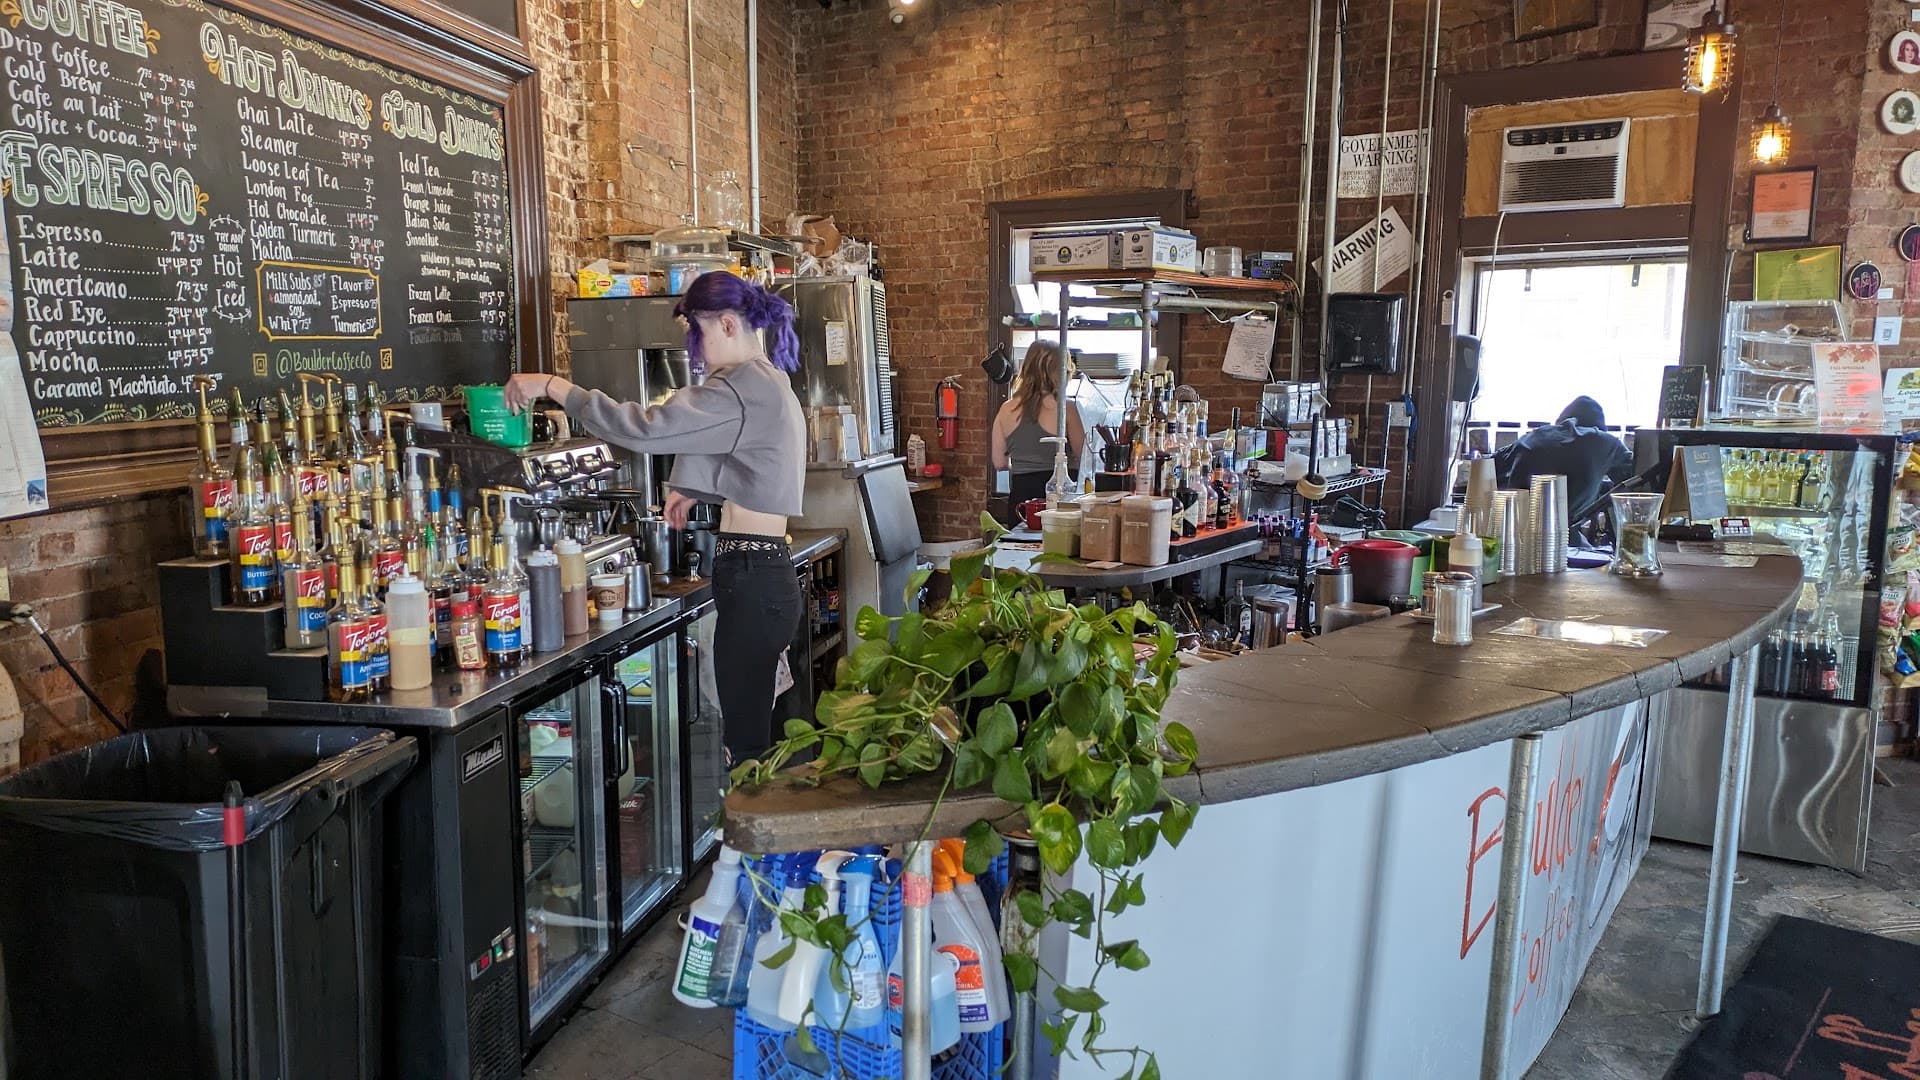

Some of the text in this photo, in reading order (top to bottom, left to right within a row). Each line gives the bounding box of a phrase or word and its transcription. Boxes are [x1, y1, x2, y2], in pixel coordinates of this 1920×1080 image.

[22, 0, 148, 57] COFFEE
[0, 27, 43, 61] Drip
[52, 42, 110, 77] Coffee
[5, 56, 46, 82] Cold
[58, 69, 102, 95] Brew
[200, 22, 369, 130] HOT DRINKS
[9, 82, 52, 106] Cafe
[64, 96, 83, 114] au
[93, 98, 122, 121] lait
[12, 103, 69, 134] Coffee
[87, 120, 137, 147] Cocoa
[237, 97, 270, 126] Chai
[276, 107, 315, 137] Latte
[381, 90, 501, 161] COLD DRINKS
[241, 125, 299, 156] Steamer
[1, 130, 197, 225] ESPRESSO
[241, 151, 280, 177] Loose
[284, 162, 309, 188] Leaf
[315, 166, 339, 190] Tea
[399, 152, 440, 178] Iced Tea
[245, 176, 313, 207] London Fog
[403, 193, 451, 214] Orange Juice
[248, 199, 269, 219] Hot
[276, 202, 327, 226] Chocolate
[405, 211, 450, 232] Italian Soda
[16, 215, 103, 244] Espresso
[250, 218, 284, 239] Golden
[290, 223, 337, 247] Turmeric
[406, 231, 439, 247] Smoothie
[18, 243, 80, 270] Latte
[251, 238, 293, 261] Matcha
[212, 254, 245, 278] Hot
[20, 266, 127, 299] Americano
[266, 271, 288, 290] Milk
[330, 274, 363, 292] Flavor
[408, 284, 451, 302] Frozen Latte
[216, 286, 246, 308] Iced
[330, 295, 369, 312] Espresso
[24, 297, 63, 322] Red
[70, 301, 107, 328] Eye
[268, 316, 298, 334] Whip
[409, 307, 451, 324] Frozen Chai
[29, 324, 135, 350] Cappuccino
[27, 350, 99, 372] Mocha
[276, 348, 371, 378] @BoulderCoffeeCo
[34, 376, 102, 399] Caramel
[108, 375, 176, 397] Macchiato
